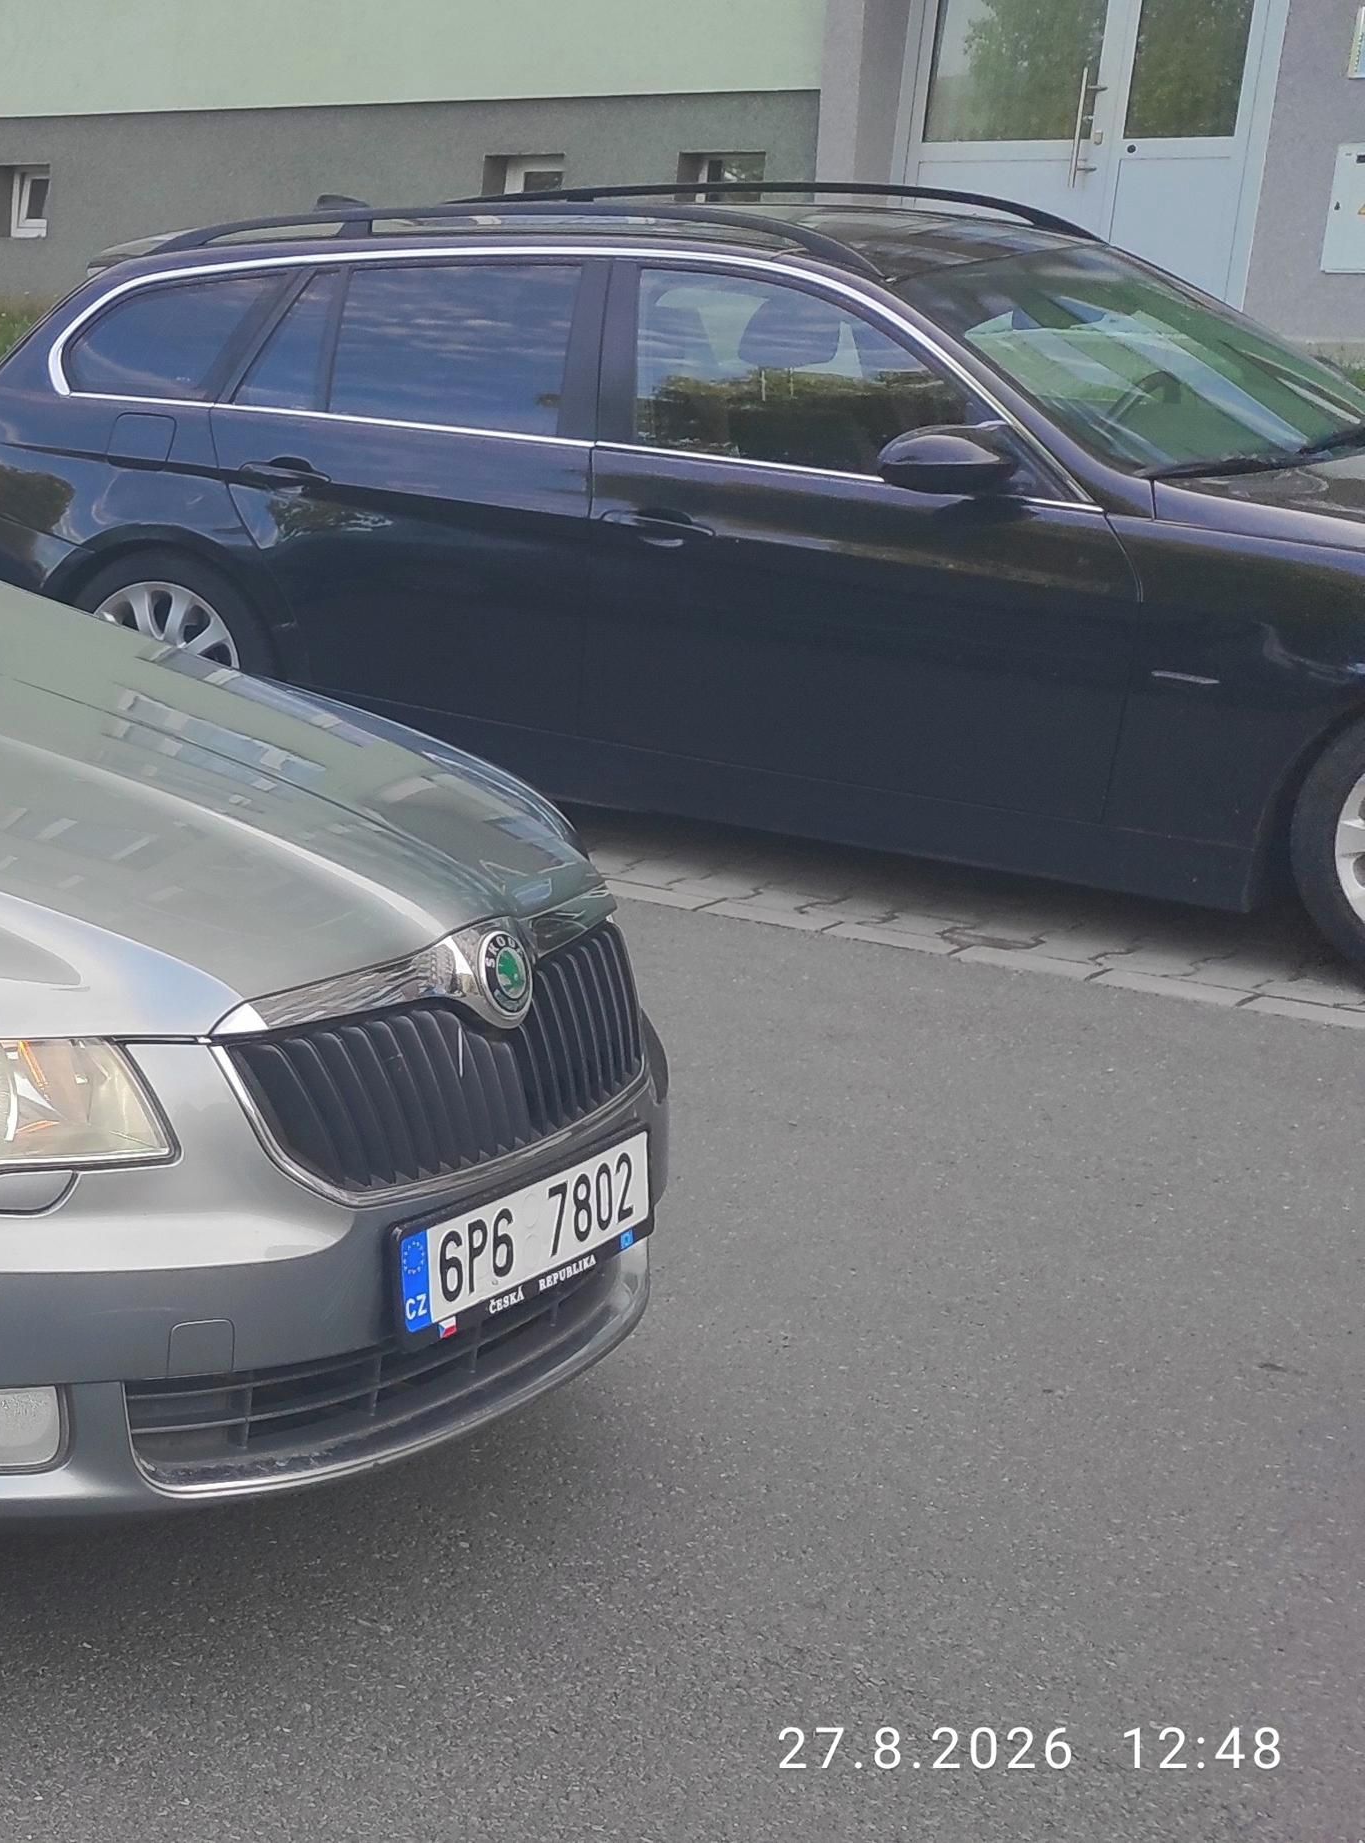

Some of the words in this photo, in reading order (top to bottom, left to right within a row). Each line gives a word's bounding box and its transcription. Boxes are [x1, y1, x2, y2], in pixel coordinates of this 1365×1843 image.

[439, 1208, 514, 1303] 6P6
[548, 1152, 634, 1258] 7802
[405, 1293, 428, 1320] CZ
[489, 1285, 525, 1314] ČESKÁ
[539, 1254, 597, 1291] REPUBLIKA
